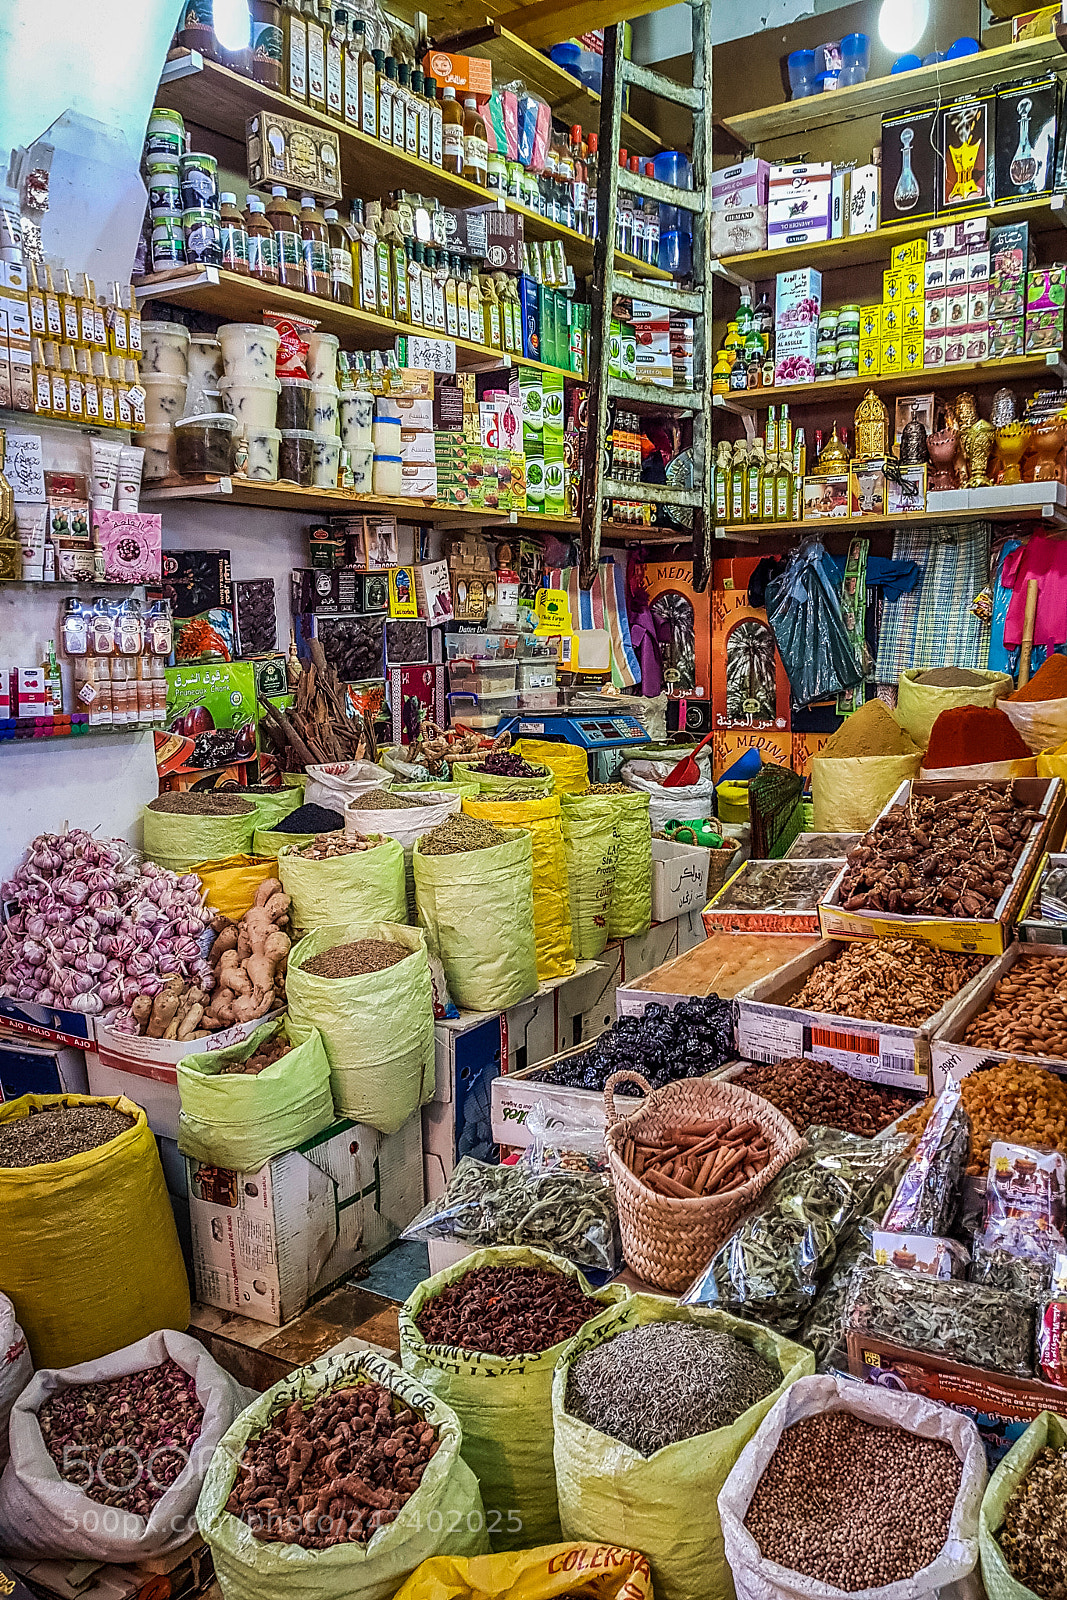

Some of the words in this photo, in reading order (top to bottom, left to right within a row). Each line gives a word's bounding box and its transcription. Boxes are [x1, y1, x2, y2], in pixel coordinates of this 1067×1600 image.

[726, 212, 753, 221] HEMANI
[788, 220, 814, 229] LAVENDER
[717, 606, 732, 620] EL
[174, 671, 201, 687] الشرق
[202, 670, 230, 685] برقوق
[716, 713, 753, 729] المدينة
[752, 719, 773, 730] تمور
[718, 742, 733, 760] EL
[737, 734, 788, 765] MEDINA
[797, 745, 814, 764] EL
[9, 1020, 24, 1029] AJO
[27, 1025, 51, 1037] AGLIO
[56, 1034, 69, 1042] AIL
[74, 1039, 91, 1048] AJO
[866, 1055, 879, 1065] OP
[938, 1053, 962, 1075] LARGE
[867, 1356, 879, 1366] 20
[411, 1391, 436, 1415] de
